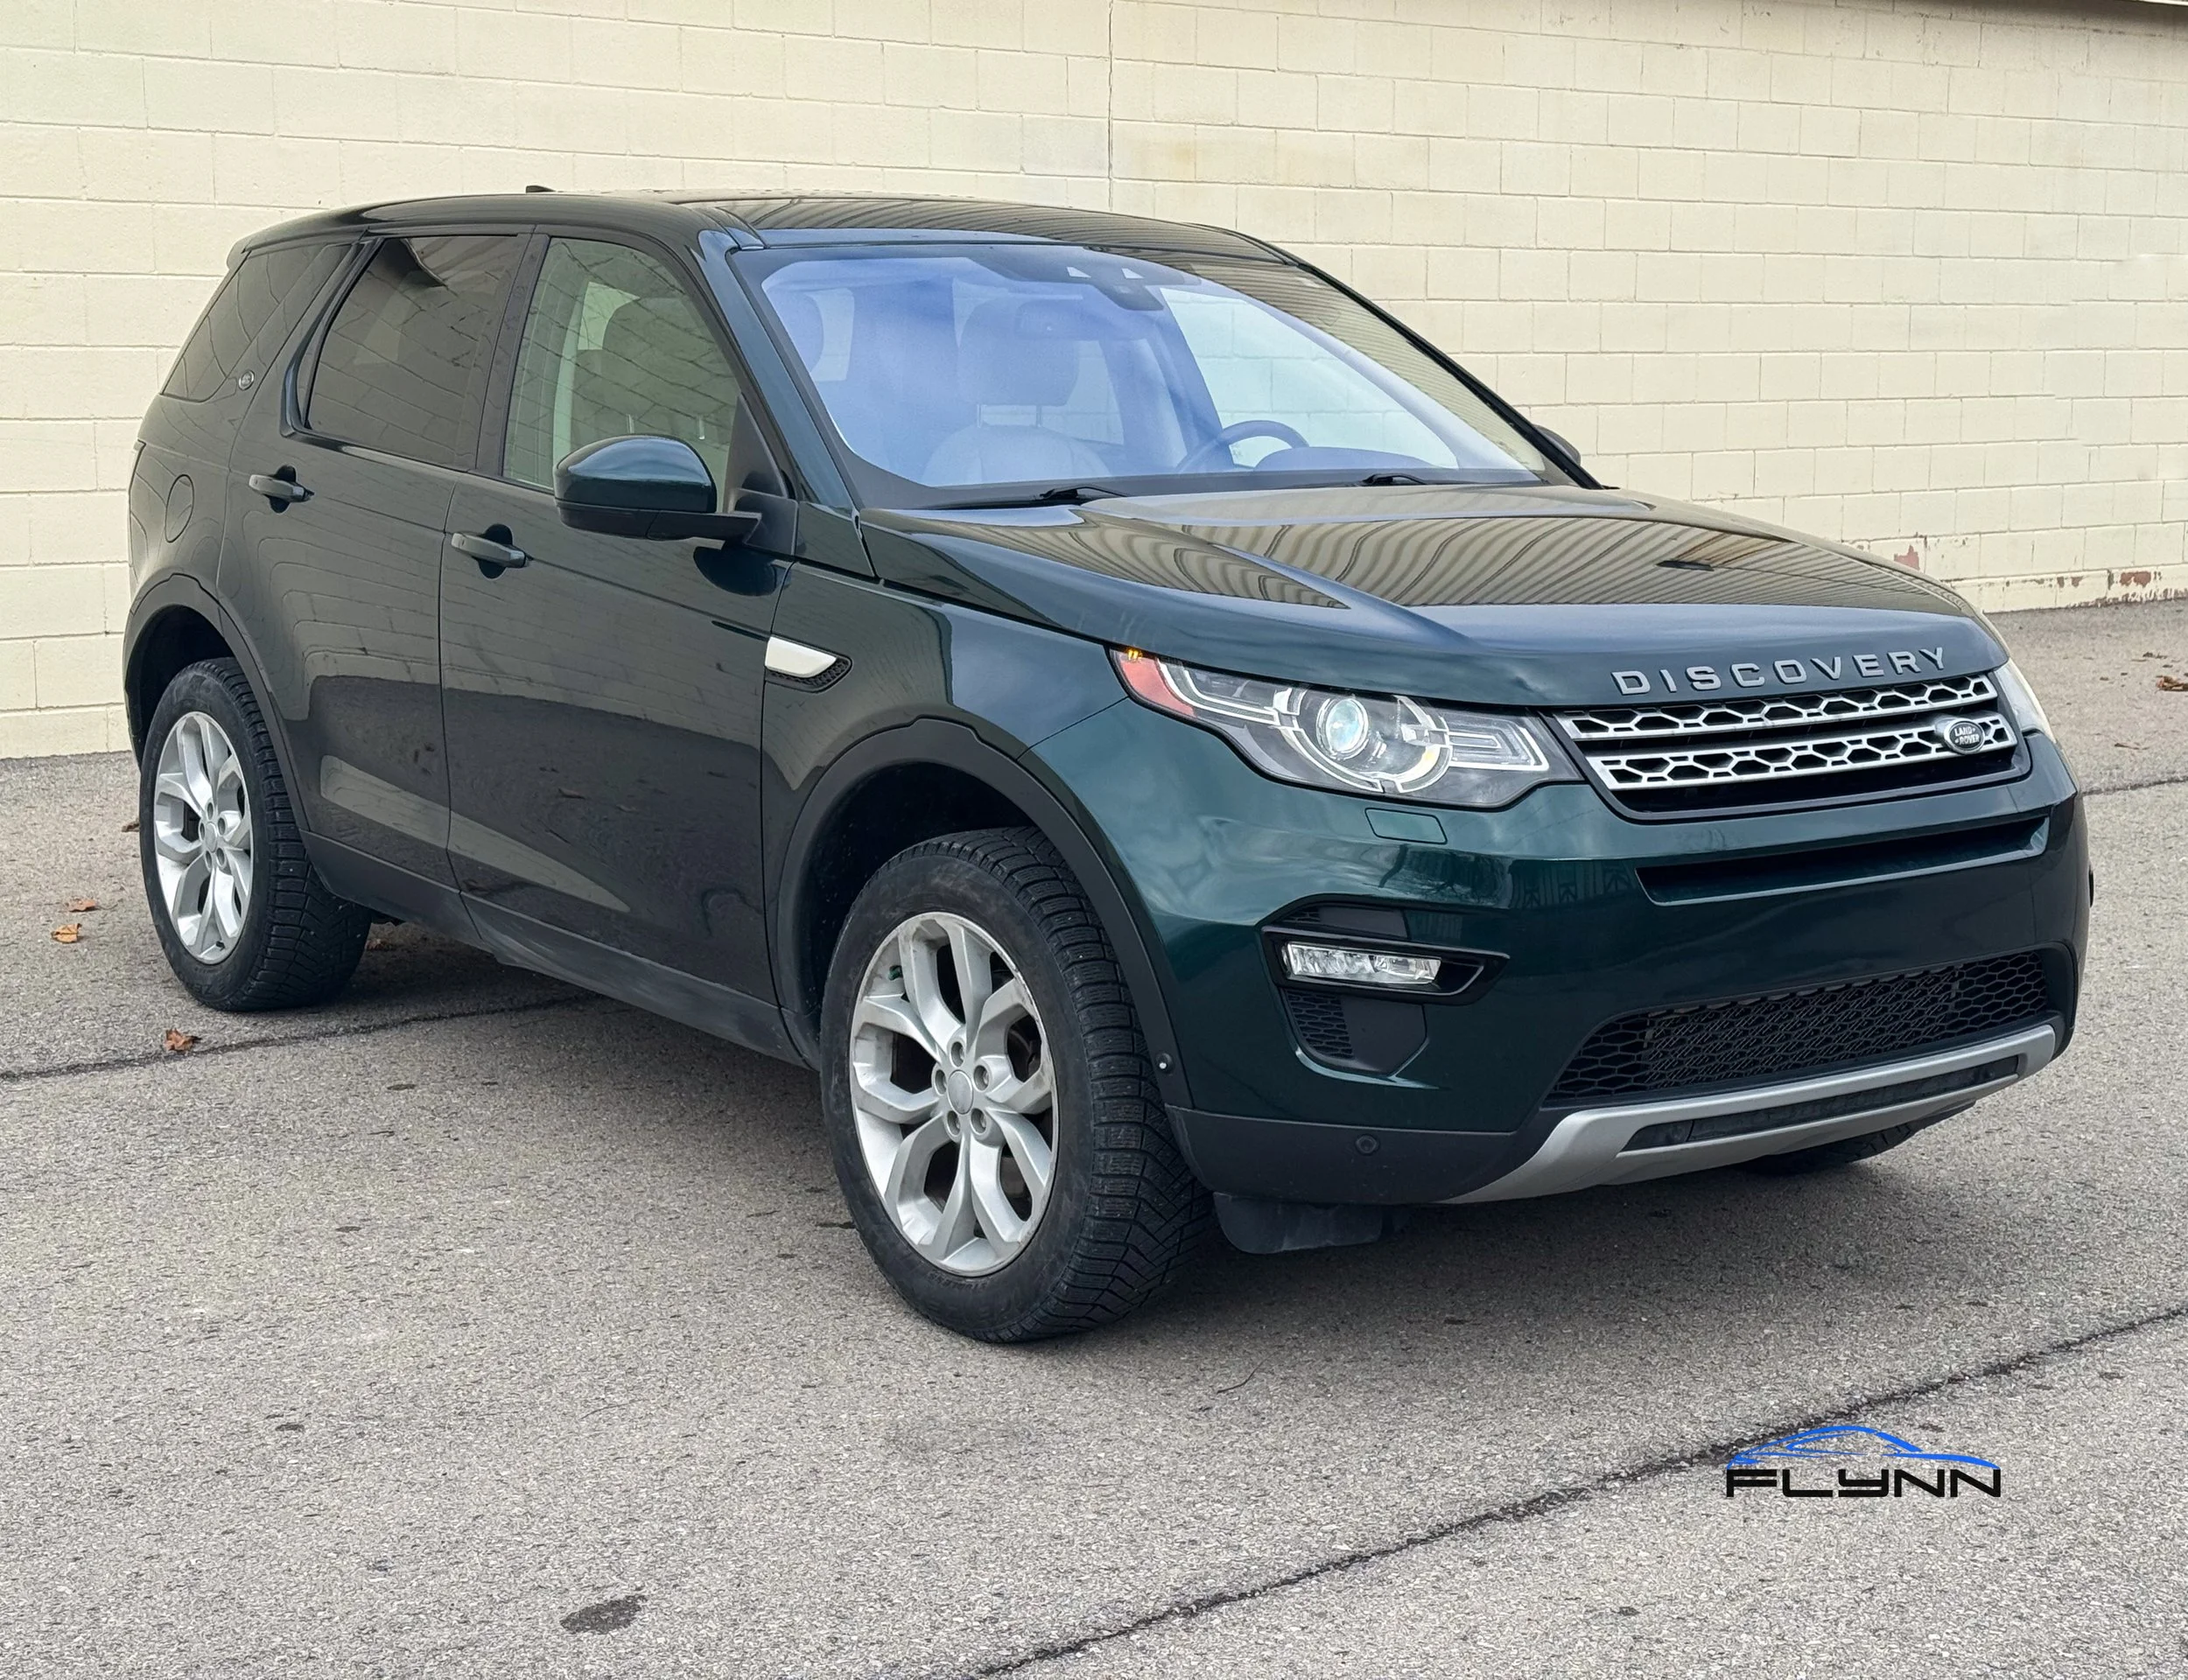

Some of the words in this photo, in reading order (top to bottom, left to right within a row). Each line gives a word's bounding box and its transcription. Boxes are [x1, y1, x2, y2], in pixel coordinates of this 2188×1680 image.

[1611, 647, 1945, 695] DISCOVERY
[1954, 726, 1973, 737] LAND
[1959, 733, 1980, 745] ROVER
